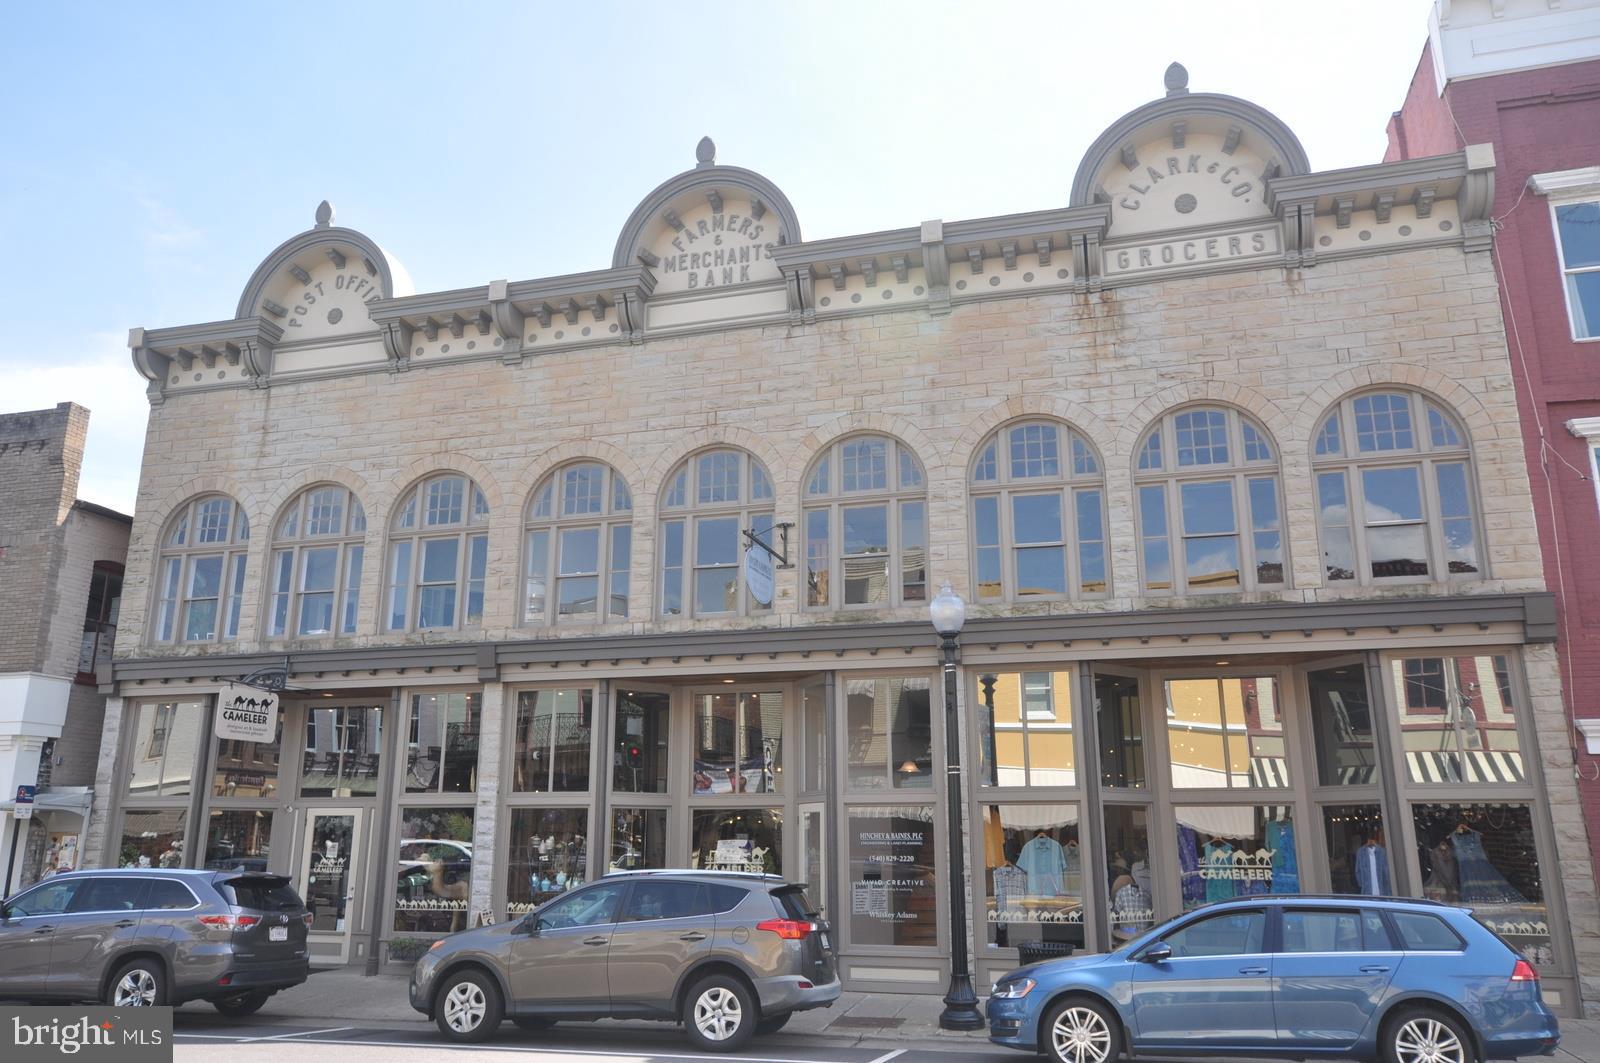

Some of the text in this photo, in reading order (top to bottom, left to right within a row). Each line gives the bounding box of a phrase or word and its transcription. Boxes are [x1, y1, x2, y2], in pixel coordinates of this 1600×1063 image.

[1120, 154, 1253, 211] CLARK & CO.
[671, 214, 764, 253] FARMERS
[714, 234, 723, 246] &
[664, 242, 774, 273] MERCHANTS
[1117, 233, 1265, 269] GROCERS
[688, 264, 750, 289] BANK
[288, 281, 324, 328] POST
[223, 711, 268, 725] CAMELEER
[868, 855, 915, 863] (540) 829-2220
[1199, 868, 1273, 881] CAMELEER
[869, 911, 918, 920] Whiskey Adams
